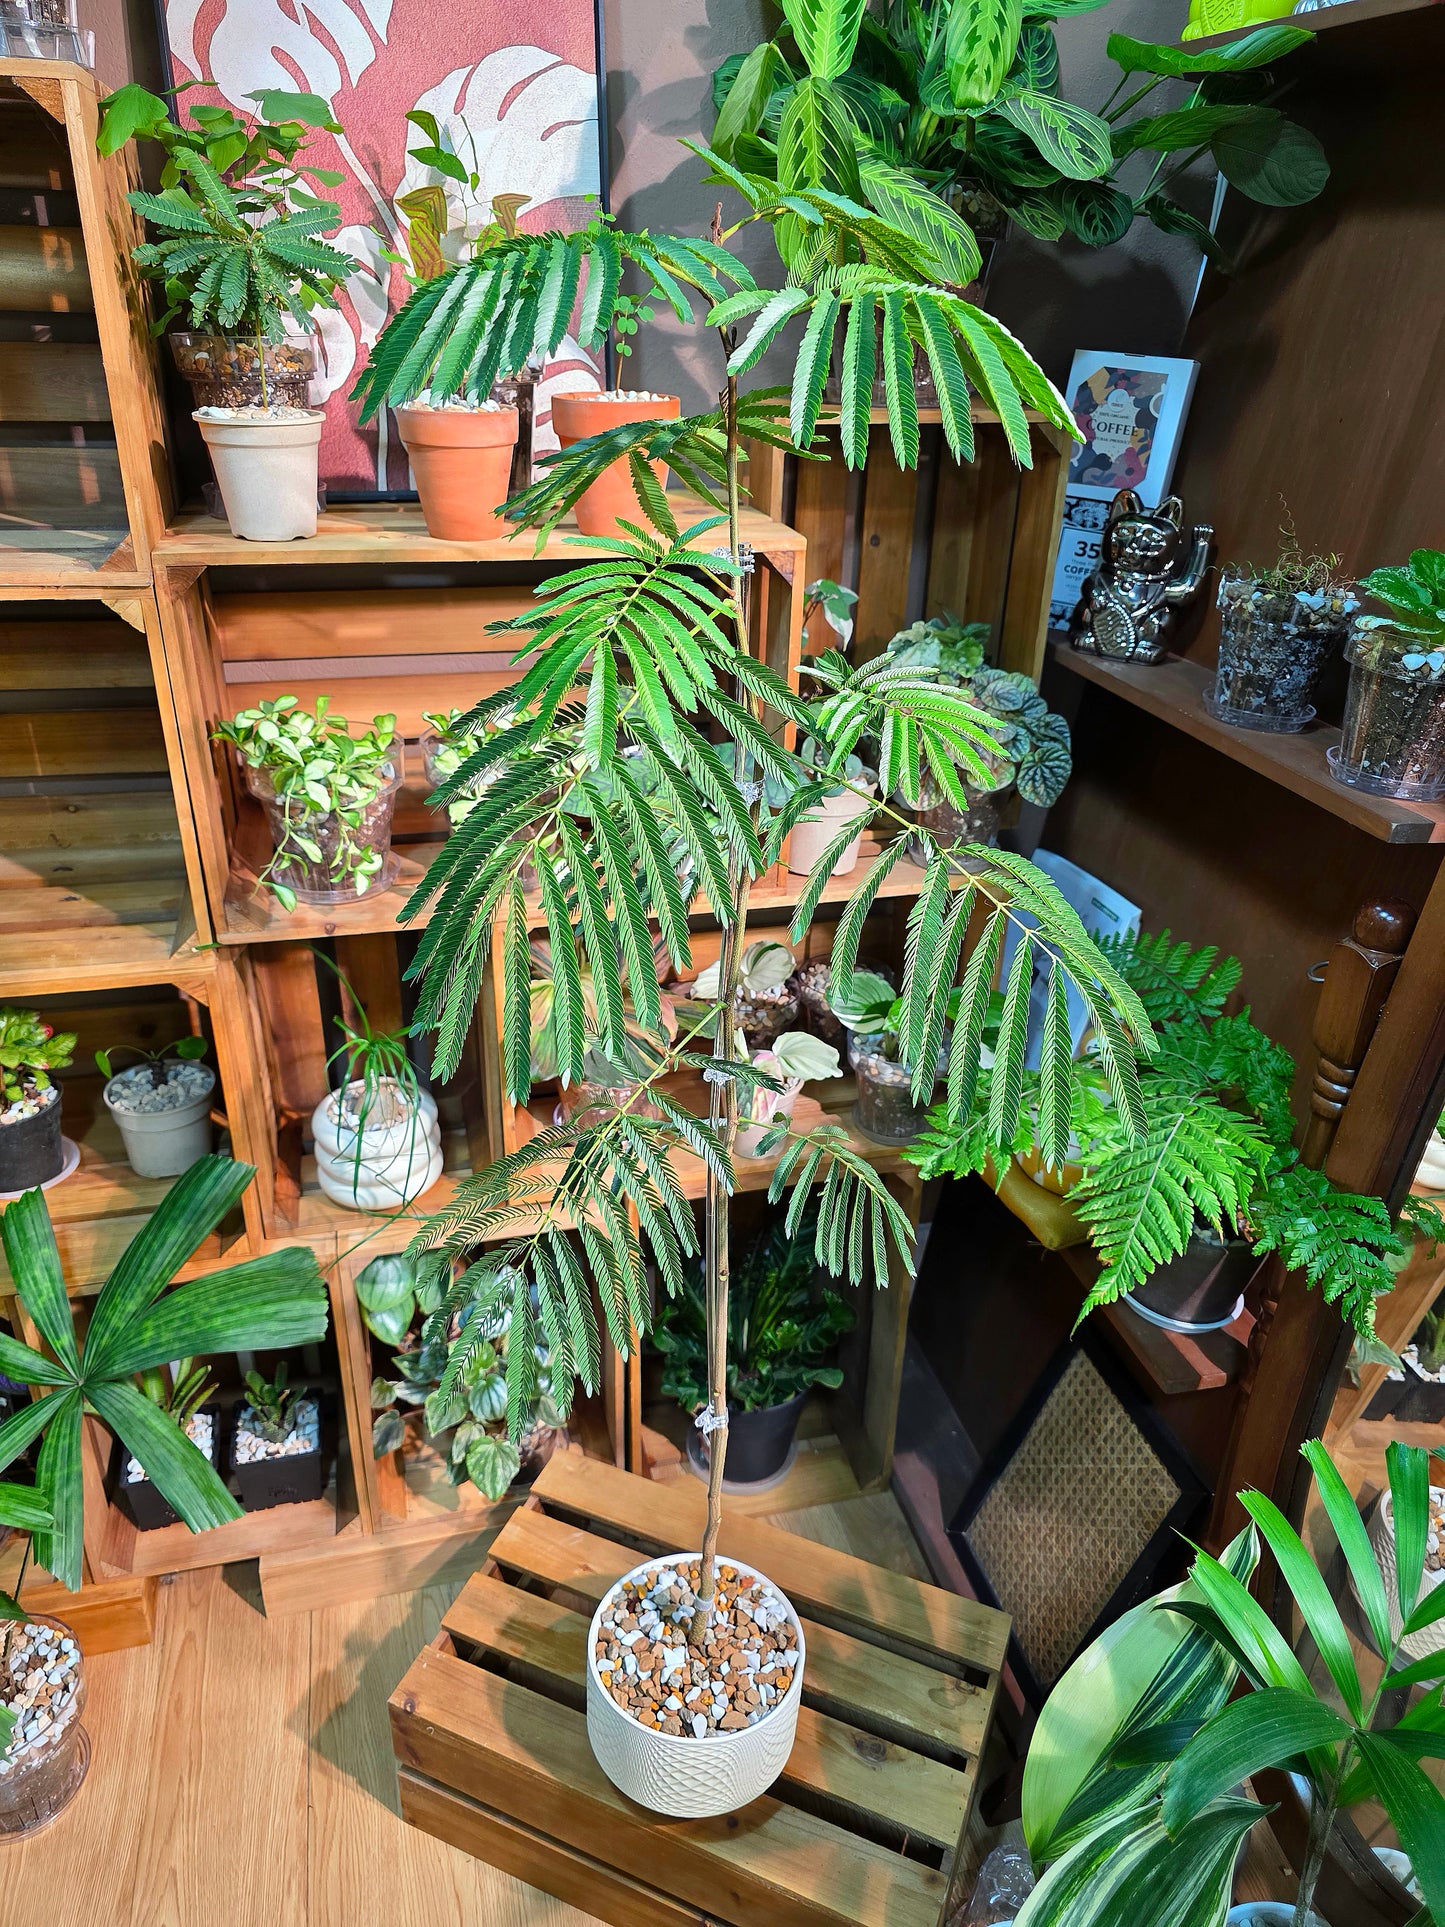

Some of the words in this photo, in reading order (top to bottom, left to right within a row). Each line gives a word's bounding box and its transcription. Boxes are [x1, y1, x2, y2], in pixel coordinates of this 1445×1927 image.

[1086, 418, 1139, 438] COFFEE
[1074, 540, 1101, 560] 35
[1063, 564, 1092, 576] COFF
